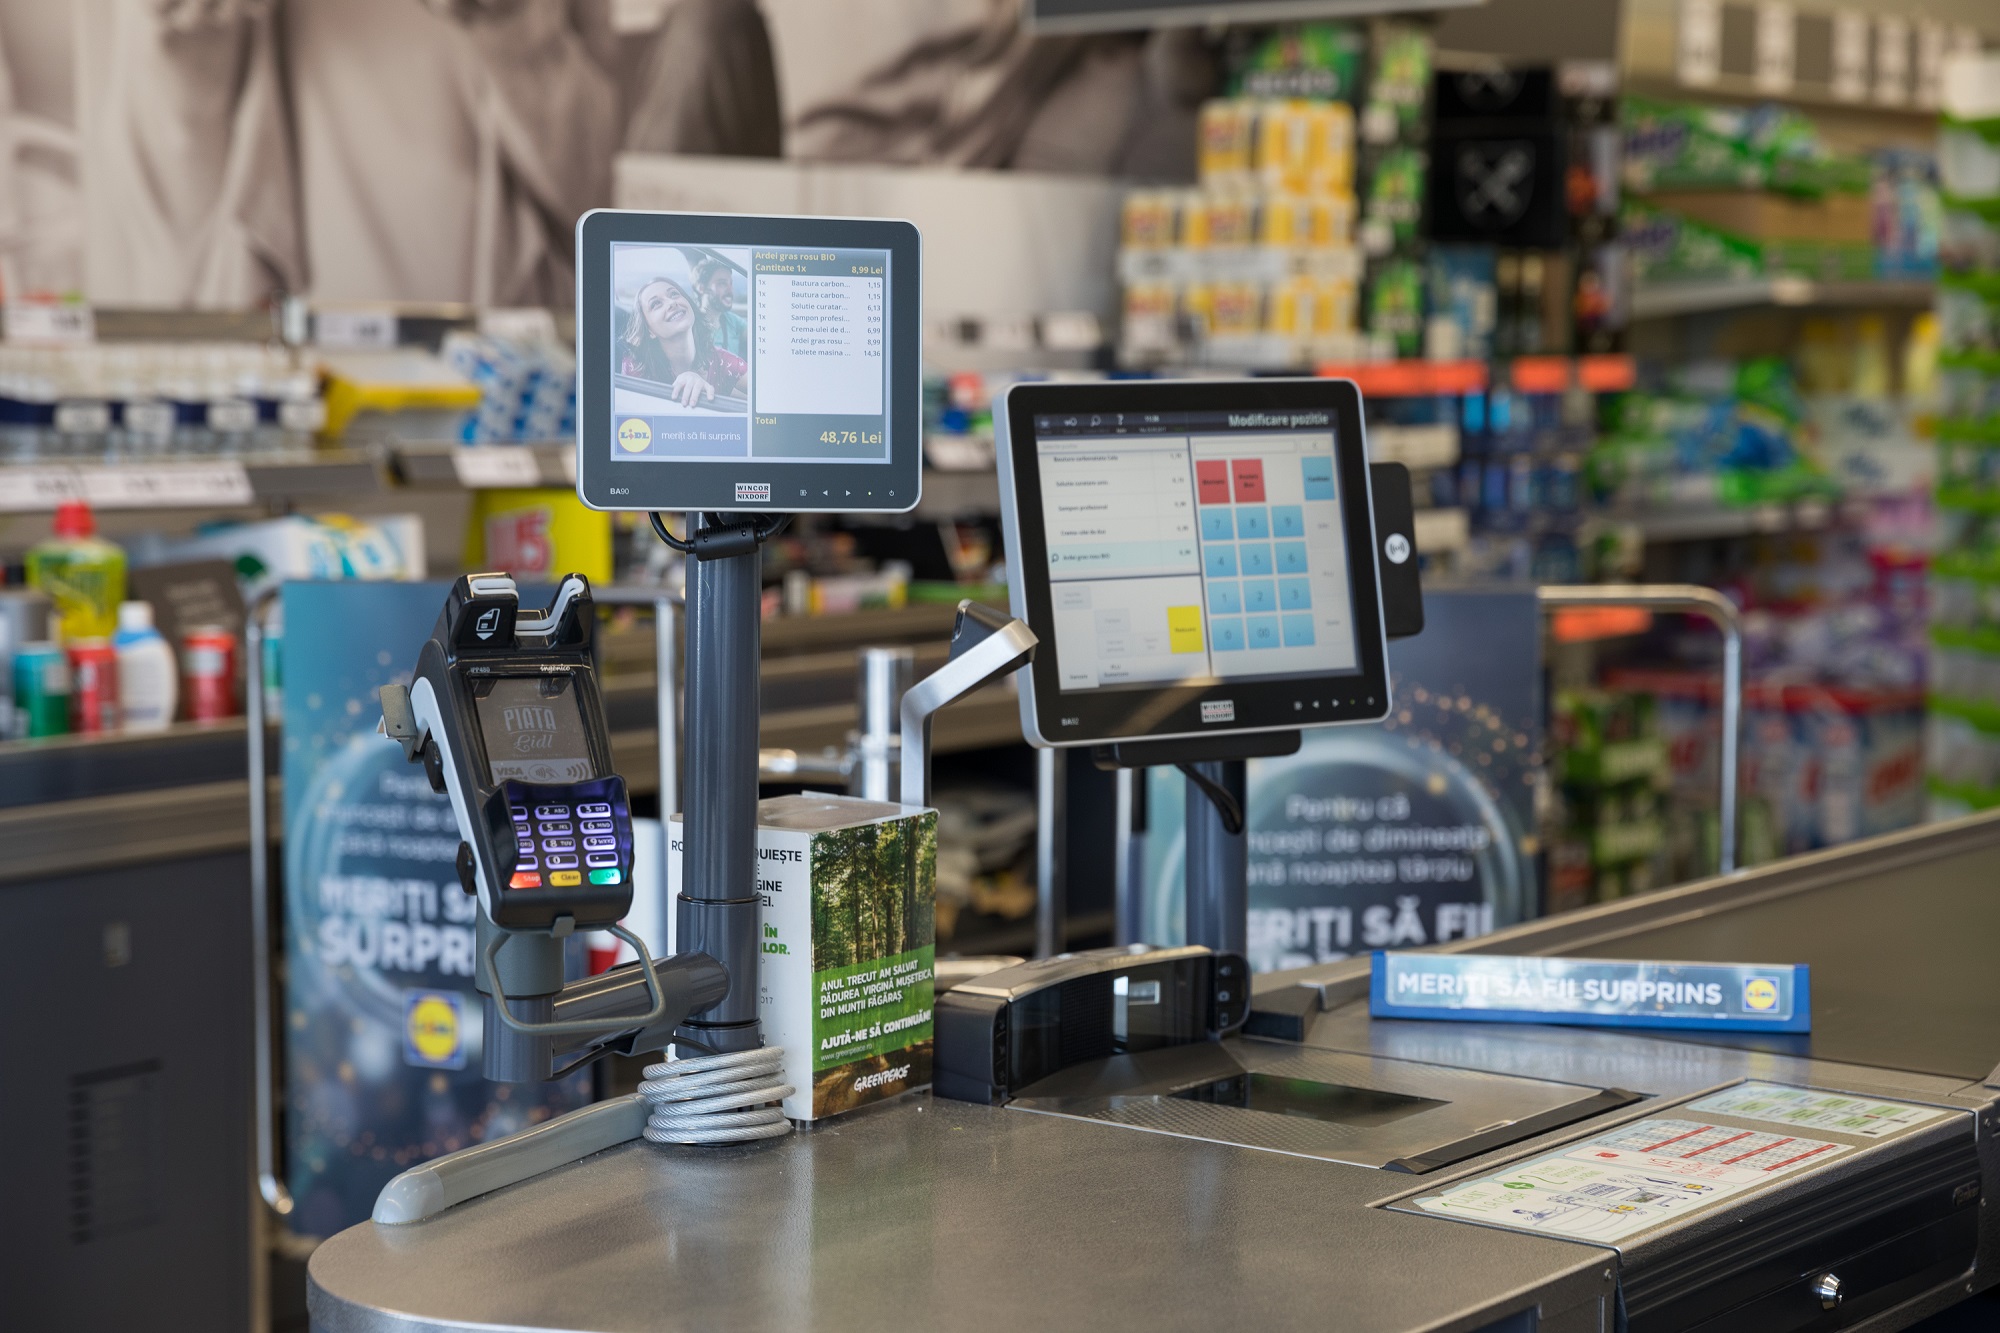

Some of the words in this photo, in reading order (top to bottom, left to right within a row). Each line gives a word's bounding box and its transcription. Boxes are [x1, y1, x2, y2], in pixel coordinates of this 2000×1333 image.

[755, 251, 777, 259] Ardei
[779, 253, 798, 262] gras
[821, 253, 836, 261] BIO
[755, 263, 795, 272] Cantitate
[851, 266, 869, 274] 8,99
[870, 266, 883, 274] Lei
[791, 314, 818, 322] Sampon
[810, 338, 826, 346] gras
[755, 417, 777, 425] Total
[1228, 413, 1288, 427] Modificare
[1290, 412, 1329, 428] pozitie
[699, 432, 707, 440] fii
[708, 432, 740, 441] surprins
[820, 431, 857, 445] 48,76
[861, 432, 882, 444] Lei
[610, 487, 630, 495] BA90
[1285, 517, 1292, 527] 9
[1218, 556, 1224, 566] 4
[1257, 591, 1263, 601] 2
[540, 664, 570, 673] ingenico
[513, 735, 553, 752] Lidl
[495, 767, 523, 775] VISA
[543, 807, 550, 815] 2
[1285, 794, 1374, 822] Pentru
[547, 823, 553, 831] 5
[588, 822, 595, 830] 6
[590, 838, 597, 846] 9
[1322, 823, 1362, 853] de
[550, 839, 557, 848] 8
[553, 856, 560, 864] 0
[764, 922, 778, 938] ÎN
[1247, 907, 1352, 956] ERIȚI
[1362, 895, 1427, 946] SĂ
[1435, 902, 1494, 942] FII
[319, 915, 476, 976] SURPR
[821, 979, 844, 992] ANUL
[847, 970, 877, 986] TRECUT
[880, 967, 891, 979] AM
[893, 960, 918, 976] SALVAT
[821, 989, 860, 1006] PĂDUREA
[863, 978, 894, 996] VIRGINĂ
[1542, 978, 1576, 999] FII
[1583, 978, 1723, 1005] SURPRINS
[821, 1007, 835, 1019] DIN
[838, 1000, 866, 1014] MUNȚII
[821, 1029, 867, 1050] AJUTĂ-NE
[869, 1021, 881, 1038] SĂ
[883, 1009, 931, 1034] CONTINUĂM!
[821, 1043, 873, 1061] www.greenpeace.ro
[854, 1064, 911, 1092] GREENPEACE
